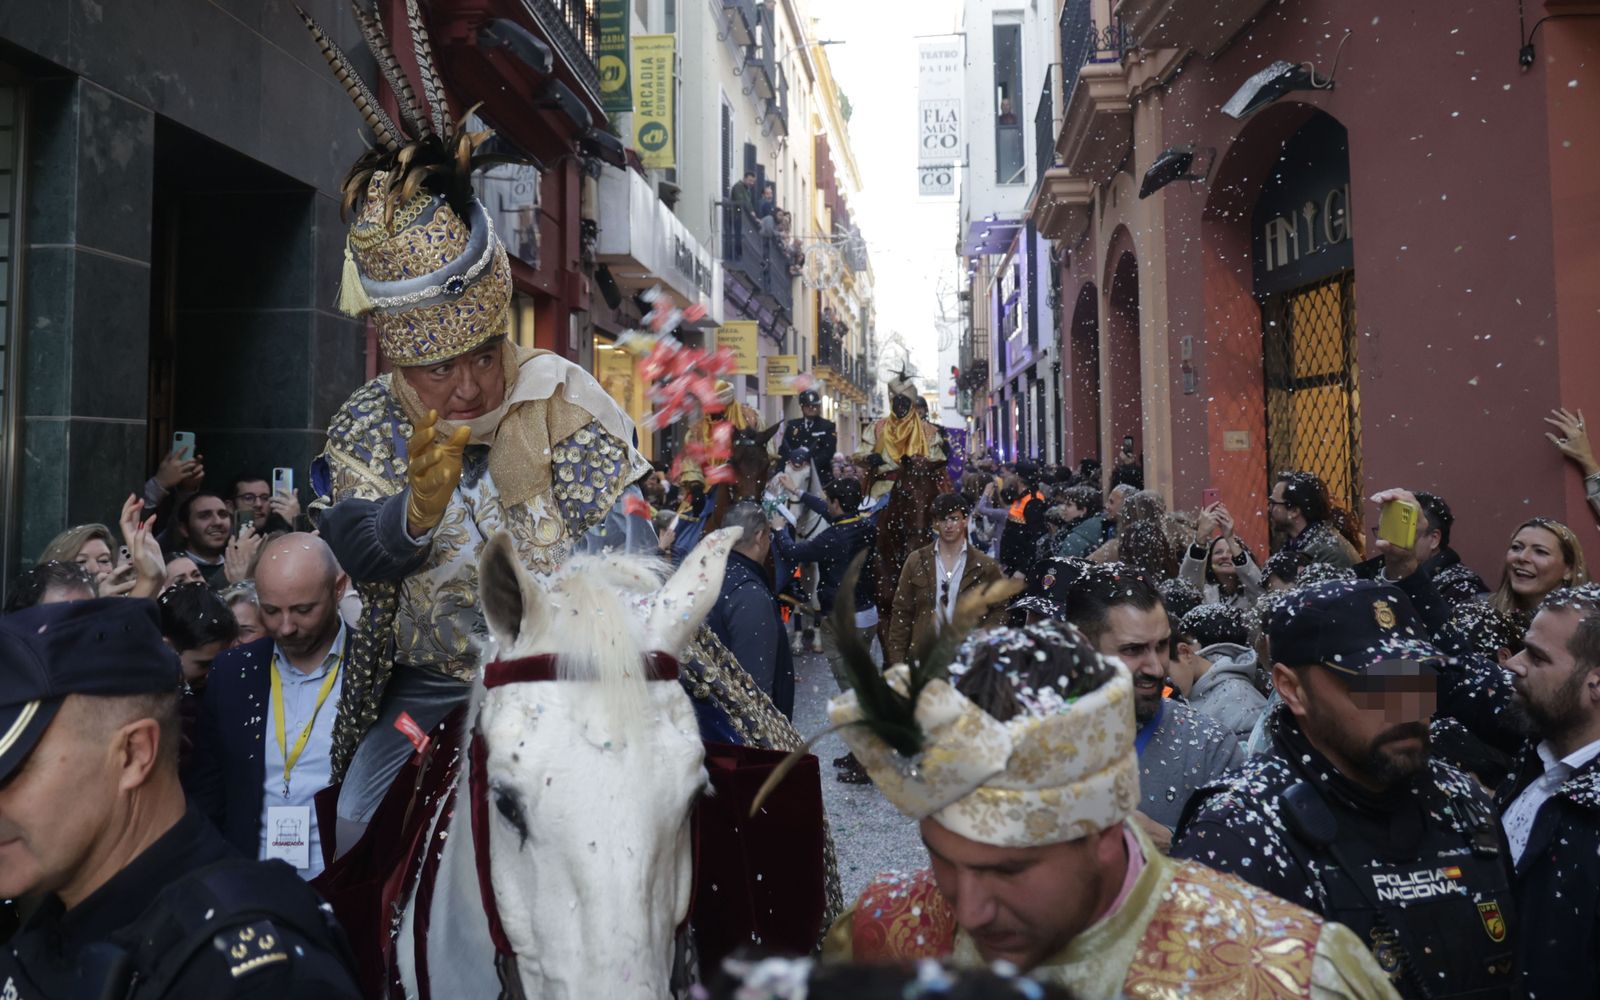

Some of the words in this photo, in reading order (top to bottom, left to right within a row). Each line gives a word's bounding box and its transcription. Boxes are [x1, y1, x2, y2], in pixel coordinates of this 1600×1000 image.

[920, 50, 958, 60] TEATRO
[640, 57, 654, 117] ARCADIA
[656, 57, 666, 117] COWORKING
[924, 109, 958, 123] FLA
[923, 134, 958, 149] CO
[921, 172, 952, 186] CO
[1372, 868, 1449, 887] POLICIA
[1376, 880, 1460, 901] NACIONAL
